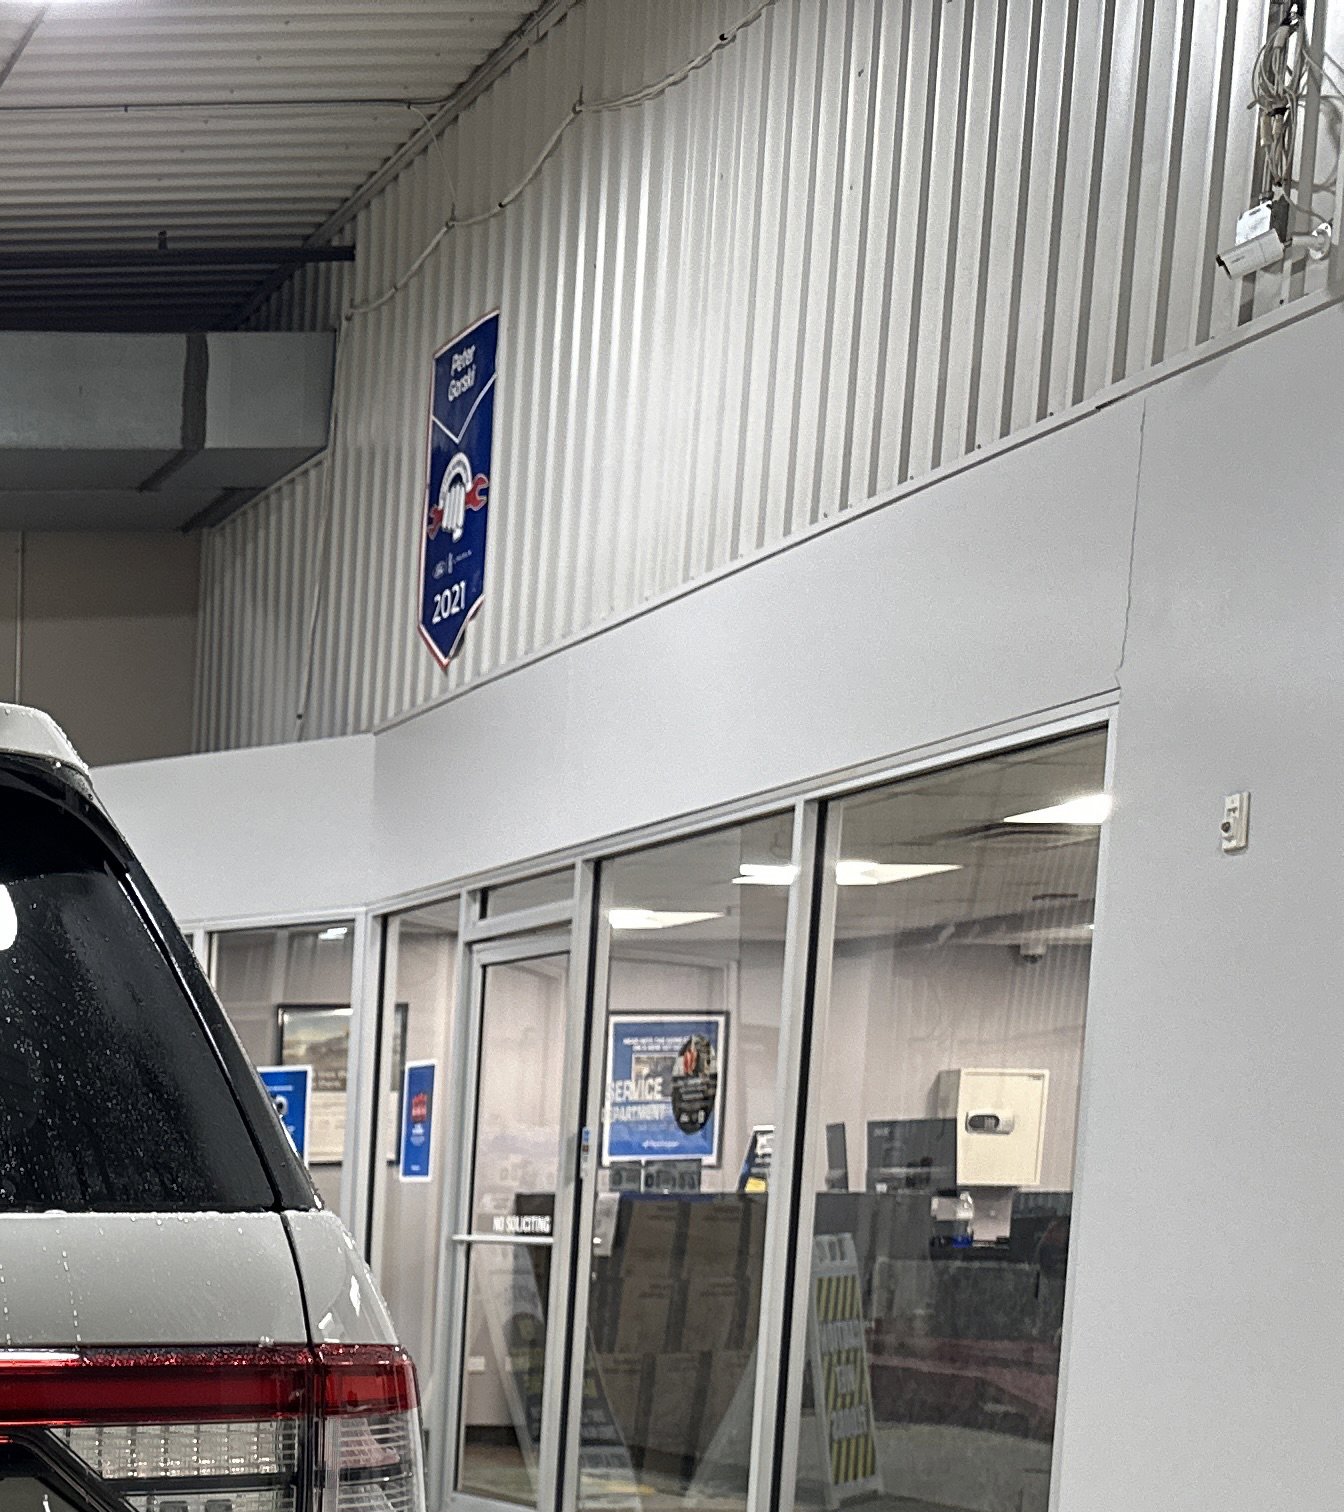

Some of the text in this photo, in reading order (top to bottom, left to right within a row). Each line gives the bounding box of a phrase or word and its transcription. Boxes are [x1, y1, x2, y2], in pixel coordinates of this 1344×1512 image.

[432, 580, 466, 625] 2021
[607, 1076, 663, 1102] SERVICE
[493, 1214, 551, 1234] NO SOLICITING
